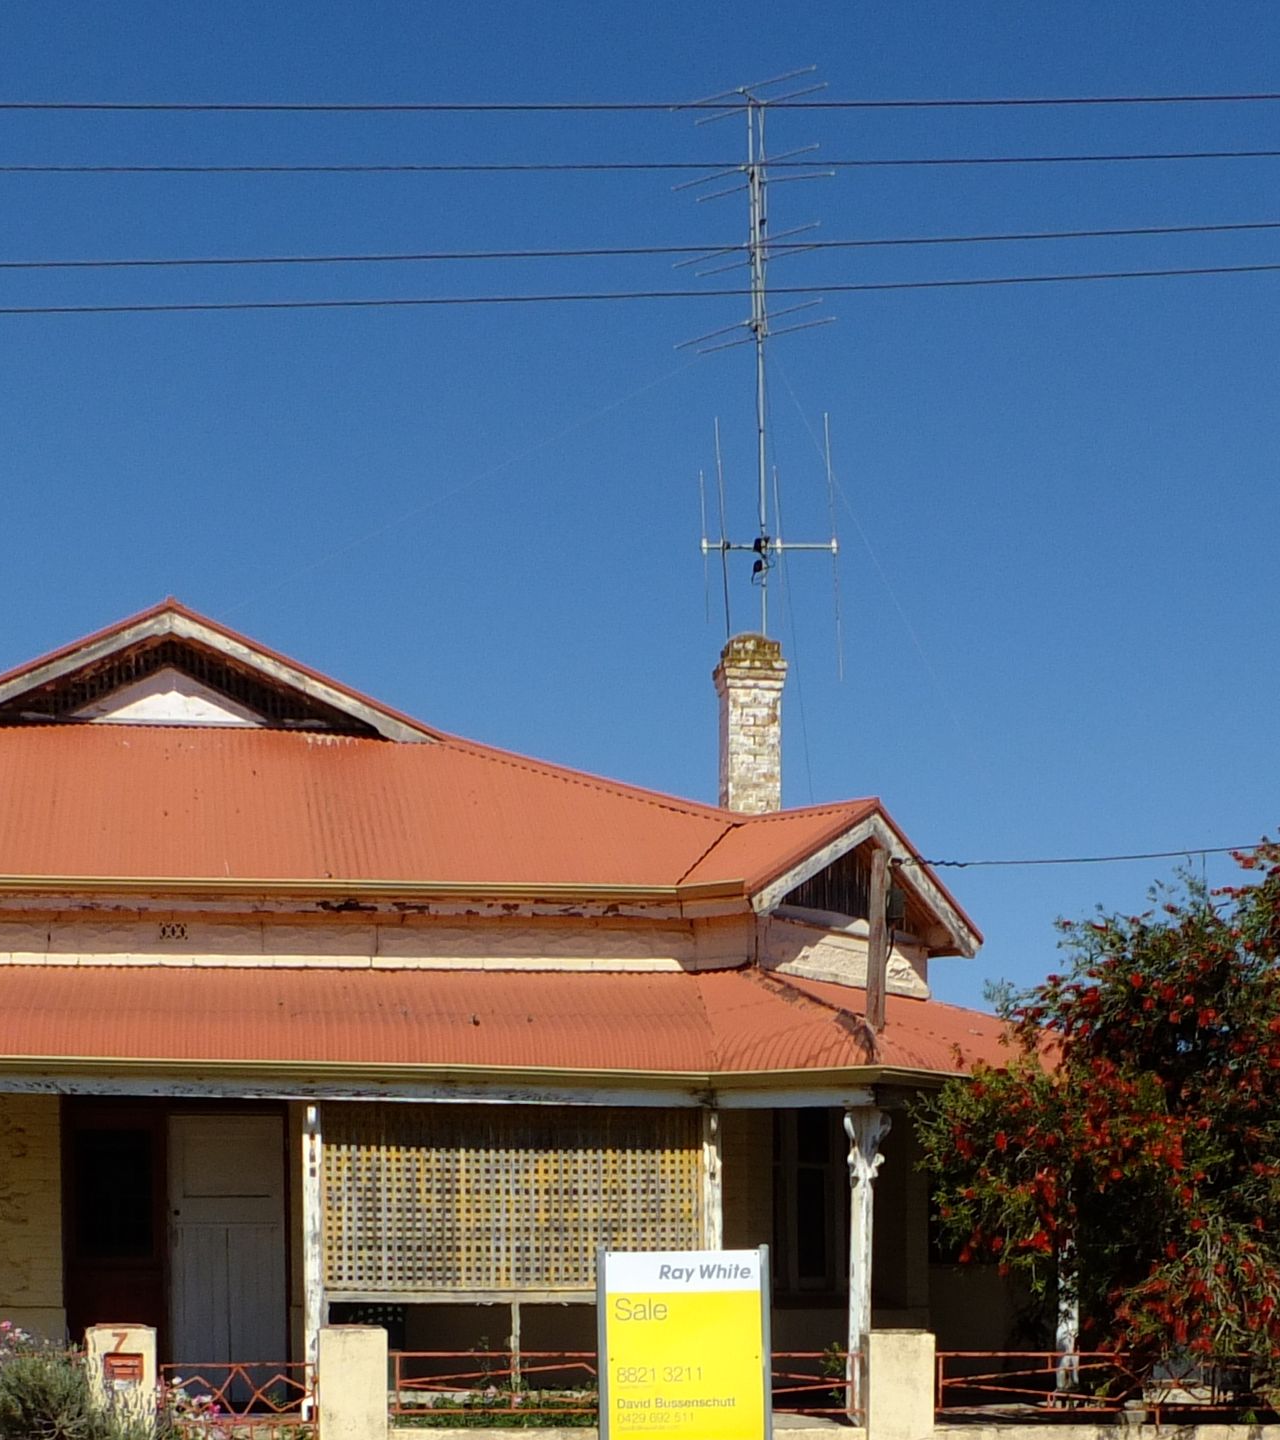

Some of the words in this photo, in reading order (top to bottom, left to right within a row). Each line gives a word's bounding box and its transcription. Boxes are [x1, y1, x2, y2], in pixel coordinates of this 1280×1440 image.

[659, 1264, 695, 1282] Ray
[699, 1264, 751, 1279] White
[615, 1297, 667, 1321] Sale
[111, 1332, 128, 1352] 7
[616, 1367, 656, 1384] 8821
[663, 1366, 702, 1383] 3211
[617, 1398, 651, 1409] David
[655, 1396, 736, 1409] Bussenschutt
[617, 1412, 647, 1424] 0429
[674, 1411, 694, 1423] 511
